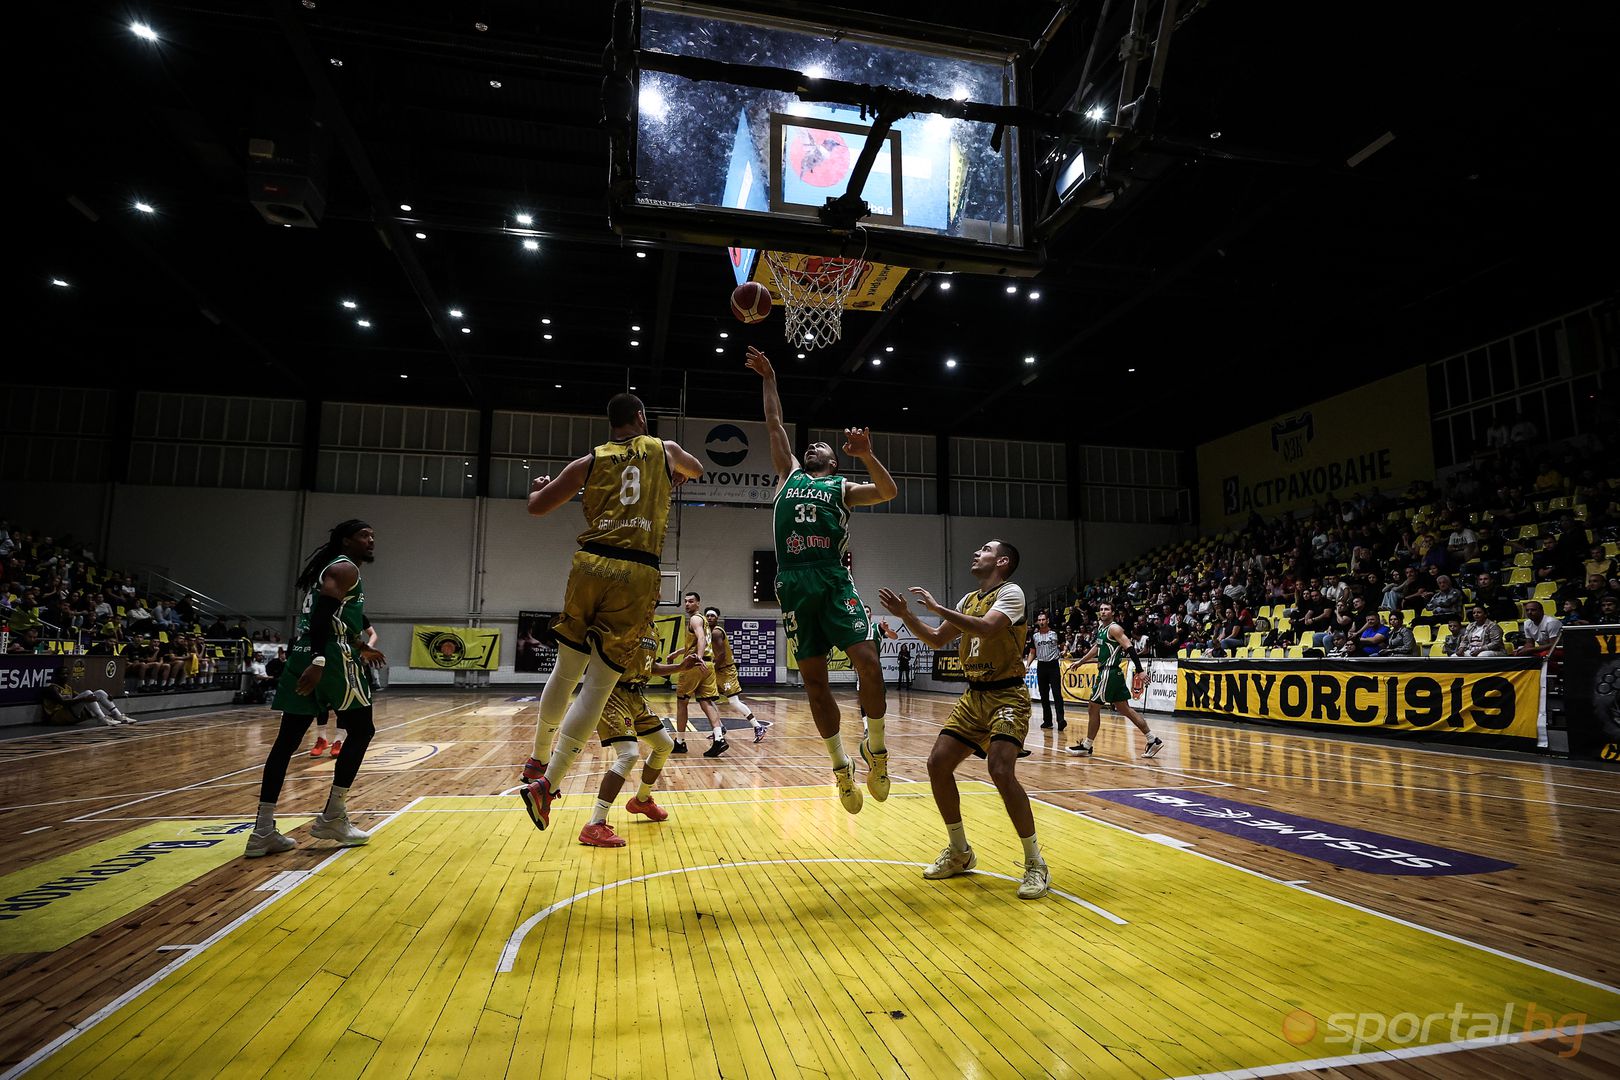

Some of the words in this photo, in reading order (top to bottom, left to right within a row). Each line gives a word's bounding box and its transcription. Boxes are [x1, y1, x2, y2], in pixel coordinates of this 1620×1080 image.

[620, 466, 640, 506] 8
[1223, 449, 1392, 515] ЗАСТРАХОВАНЕ
[785, 488, 832, 503] BALKAN
[794, 504, 817, 523] 33
[970, 636, 980, 658] 12
[965, 662, 996, 671] DMIRAL
[1151, 671, 1178, 684] бщина
[1153, 689, 1177, 698] www.pe
[1234, 818, 1453, 870] SESAME
